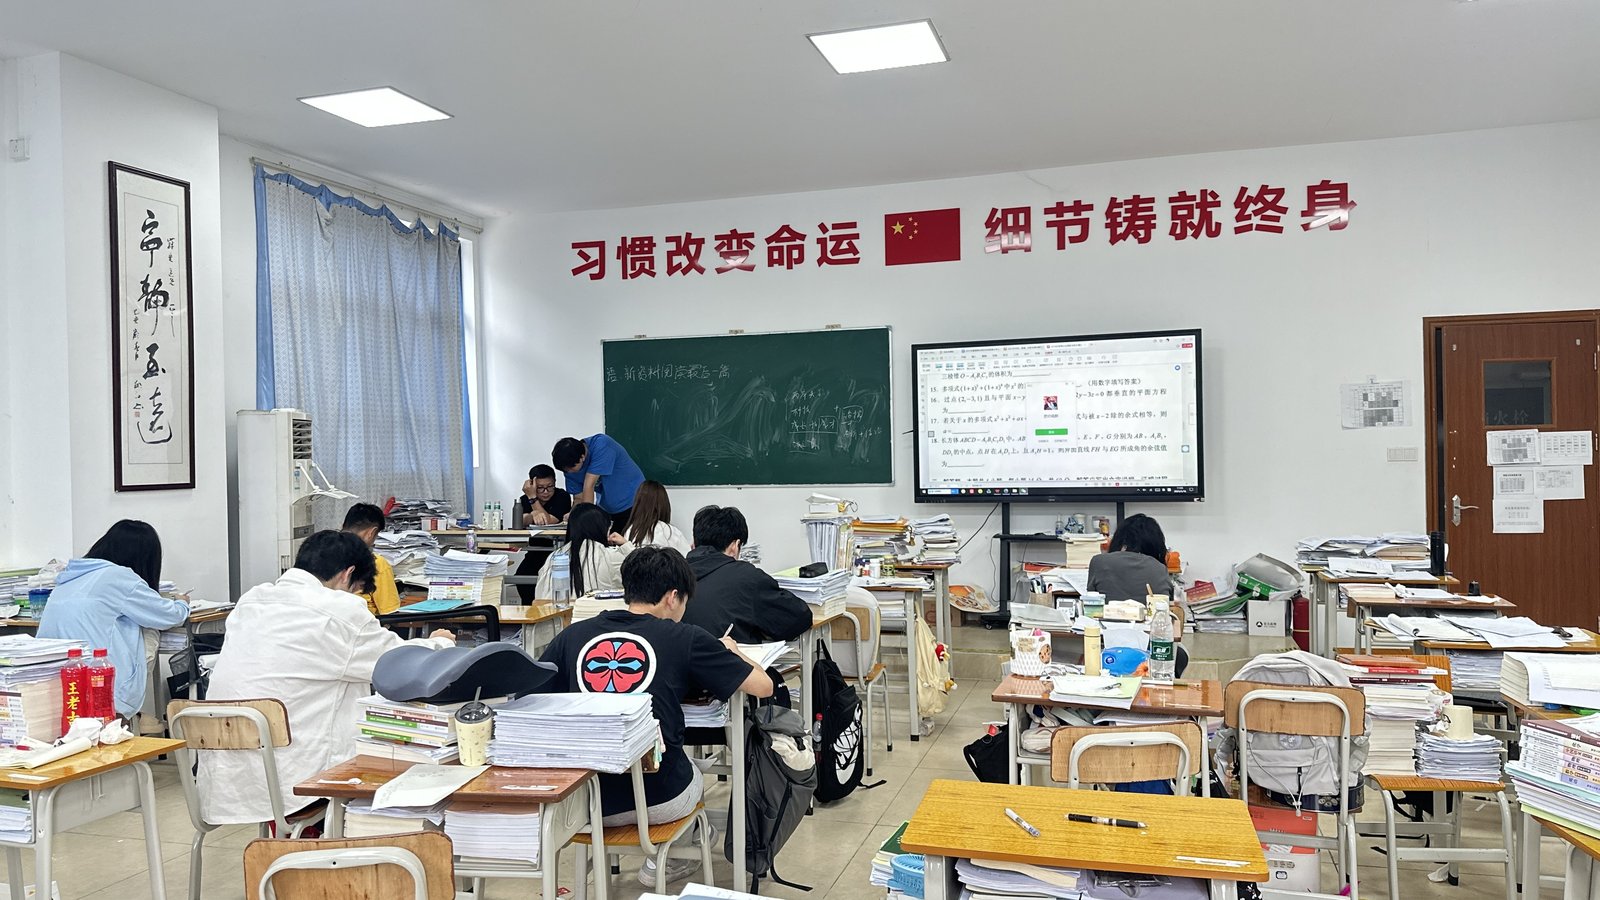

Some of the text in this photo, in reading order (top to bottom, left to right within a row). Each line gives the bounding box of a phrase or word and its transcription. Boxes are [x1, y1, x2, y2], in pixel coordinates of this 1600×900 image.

[571, 179, 1358, 281] 习惯改变命运 细节铸就终身
